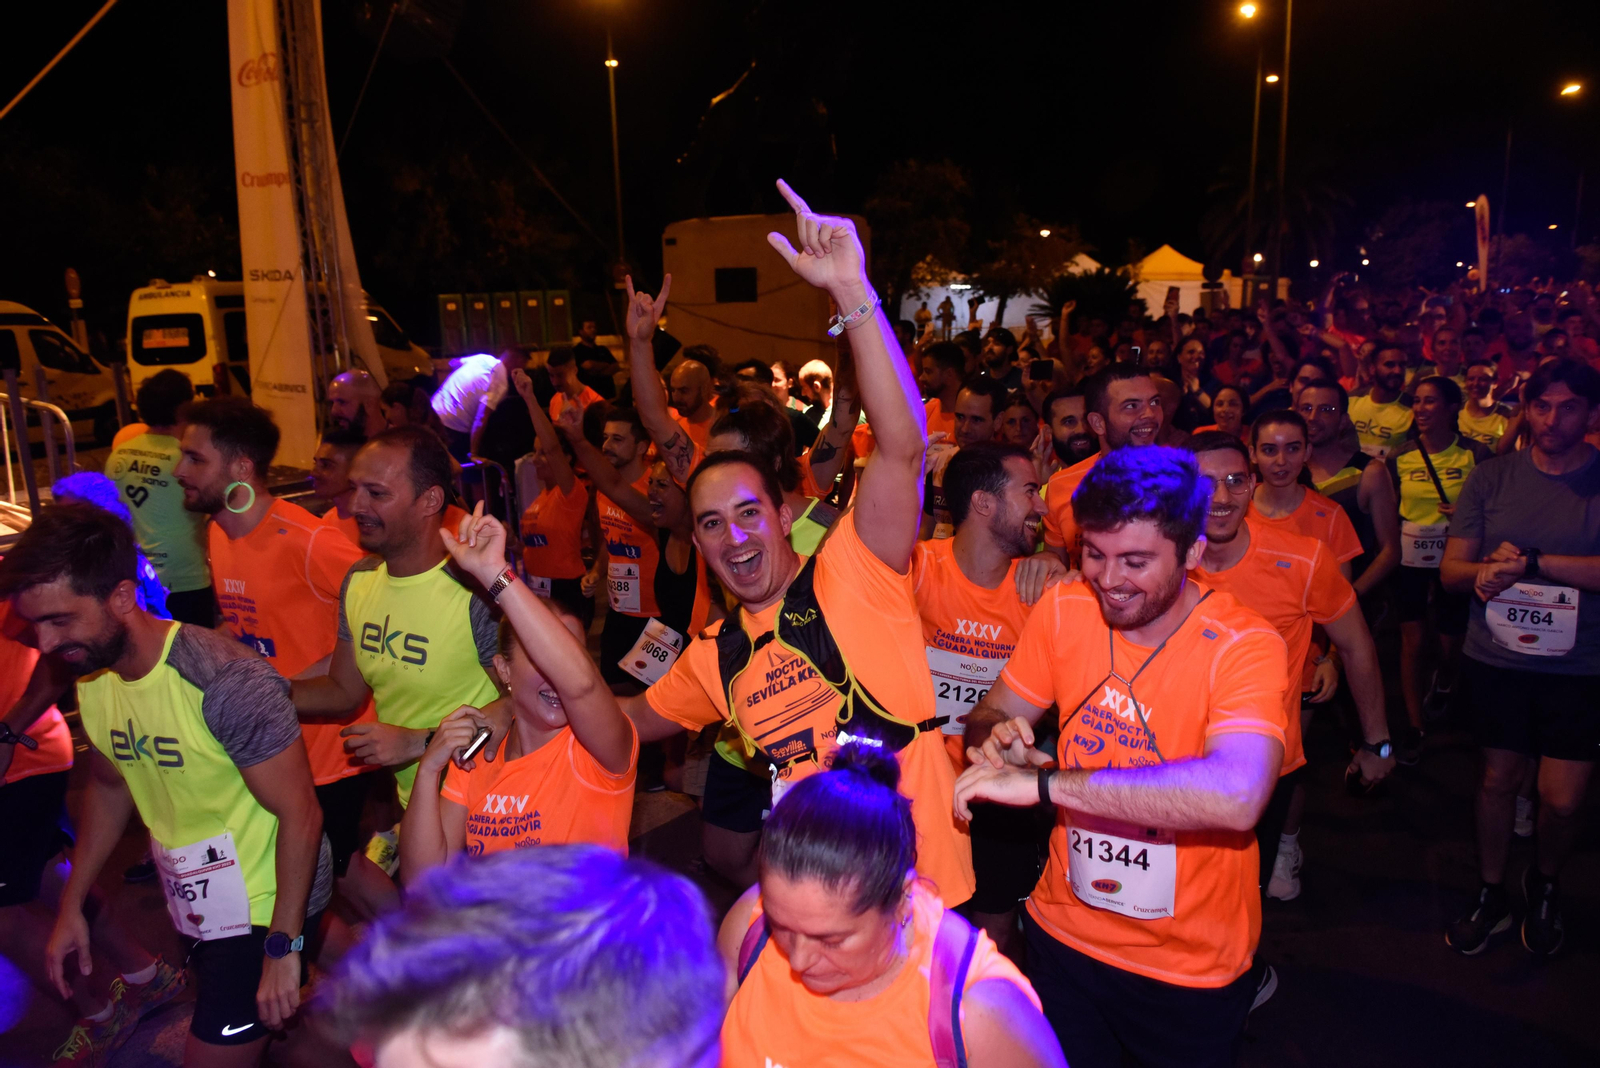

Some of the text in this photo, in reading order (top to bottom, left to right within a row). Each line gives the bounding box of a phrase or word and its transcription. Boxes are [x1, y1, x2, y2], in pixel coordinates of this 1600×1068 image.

[138, 290, 191, 300] AMBULANCIA
[1354, 418, 1392, 440] eks
[128, 459, 161, 476] Aire
[1410, 467, 1462, 482] es
[141, 476, 168, 488] sano
[1413, 540, 1444, 550] 5670
[223, 578, 246, 595] XXXV
[1507, 607, 1554, 626] 8764
[936, 628, 972, 645] CARRERA
[955, 619, 1002, 641] XXXV
[360, 614, 430, 666] eks
[765, 658, 808, 683] NOCTU
[746, 675, 797, 708] SEVILLA
[1099, 685, 1153, 723] XXXV
[110, 717, 184, 768] eks
[482, 793, 530, 815] XXXV
[1072, 829, 1150, 871] 21344
[1133, 904, 1168, 914] Cruzcampo
[220, 922, 250, 932] Cruzcampo
